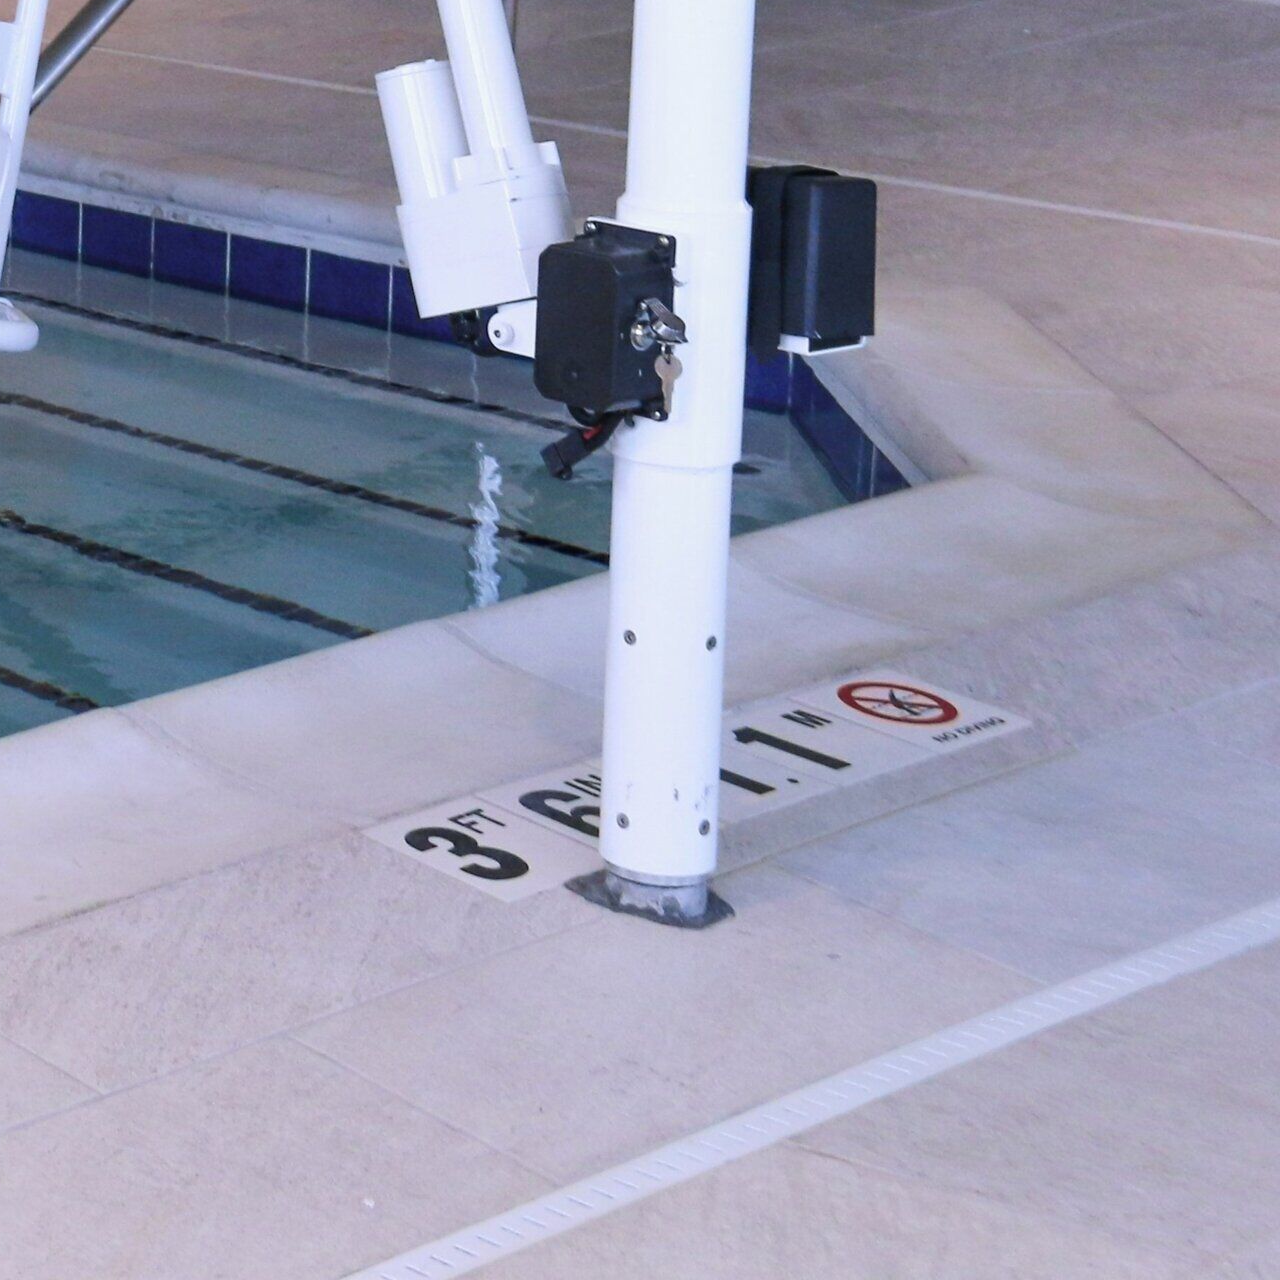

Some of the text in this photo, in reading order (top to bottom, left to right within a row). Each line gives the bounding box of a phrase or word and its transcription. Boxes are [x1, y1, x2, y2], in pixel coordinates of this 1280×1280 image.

[782, 709, 832, 729] M
[449, 808, 506, 835] FT
[519, 790, 600, 838] 6
[405, 828, 529, 881] 3
